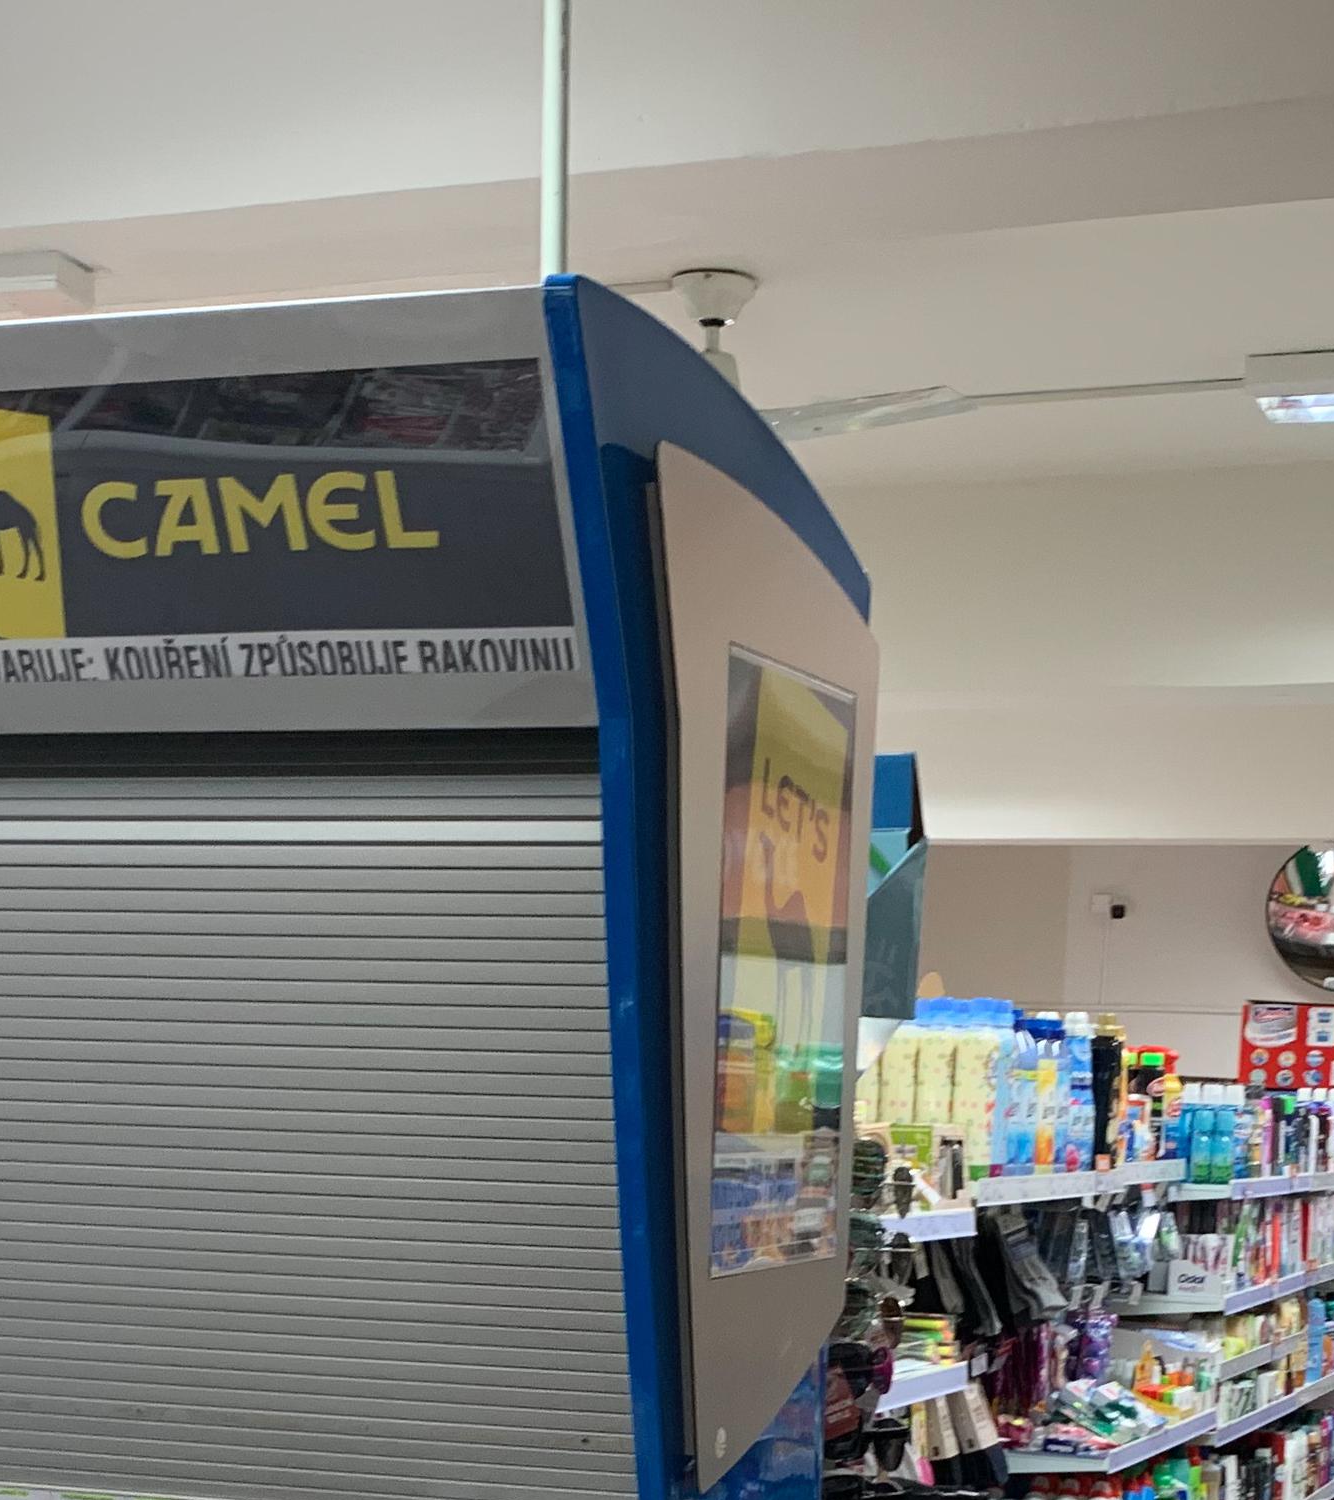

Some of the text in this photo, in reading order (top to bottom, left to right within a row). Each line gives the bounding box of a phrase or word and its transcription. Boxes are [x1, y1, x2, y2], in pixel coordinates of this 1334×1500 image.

[81, 469, 440, 560] CAMEL
[104, 636, 232, 681] KOUŘENÍ
[237, 634, 409, 678] ZPŮSOBUJE
[419, 637, 575, 674] RAKOVINU
[761, 757, 830, 863] LET'S
